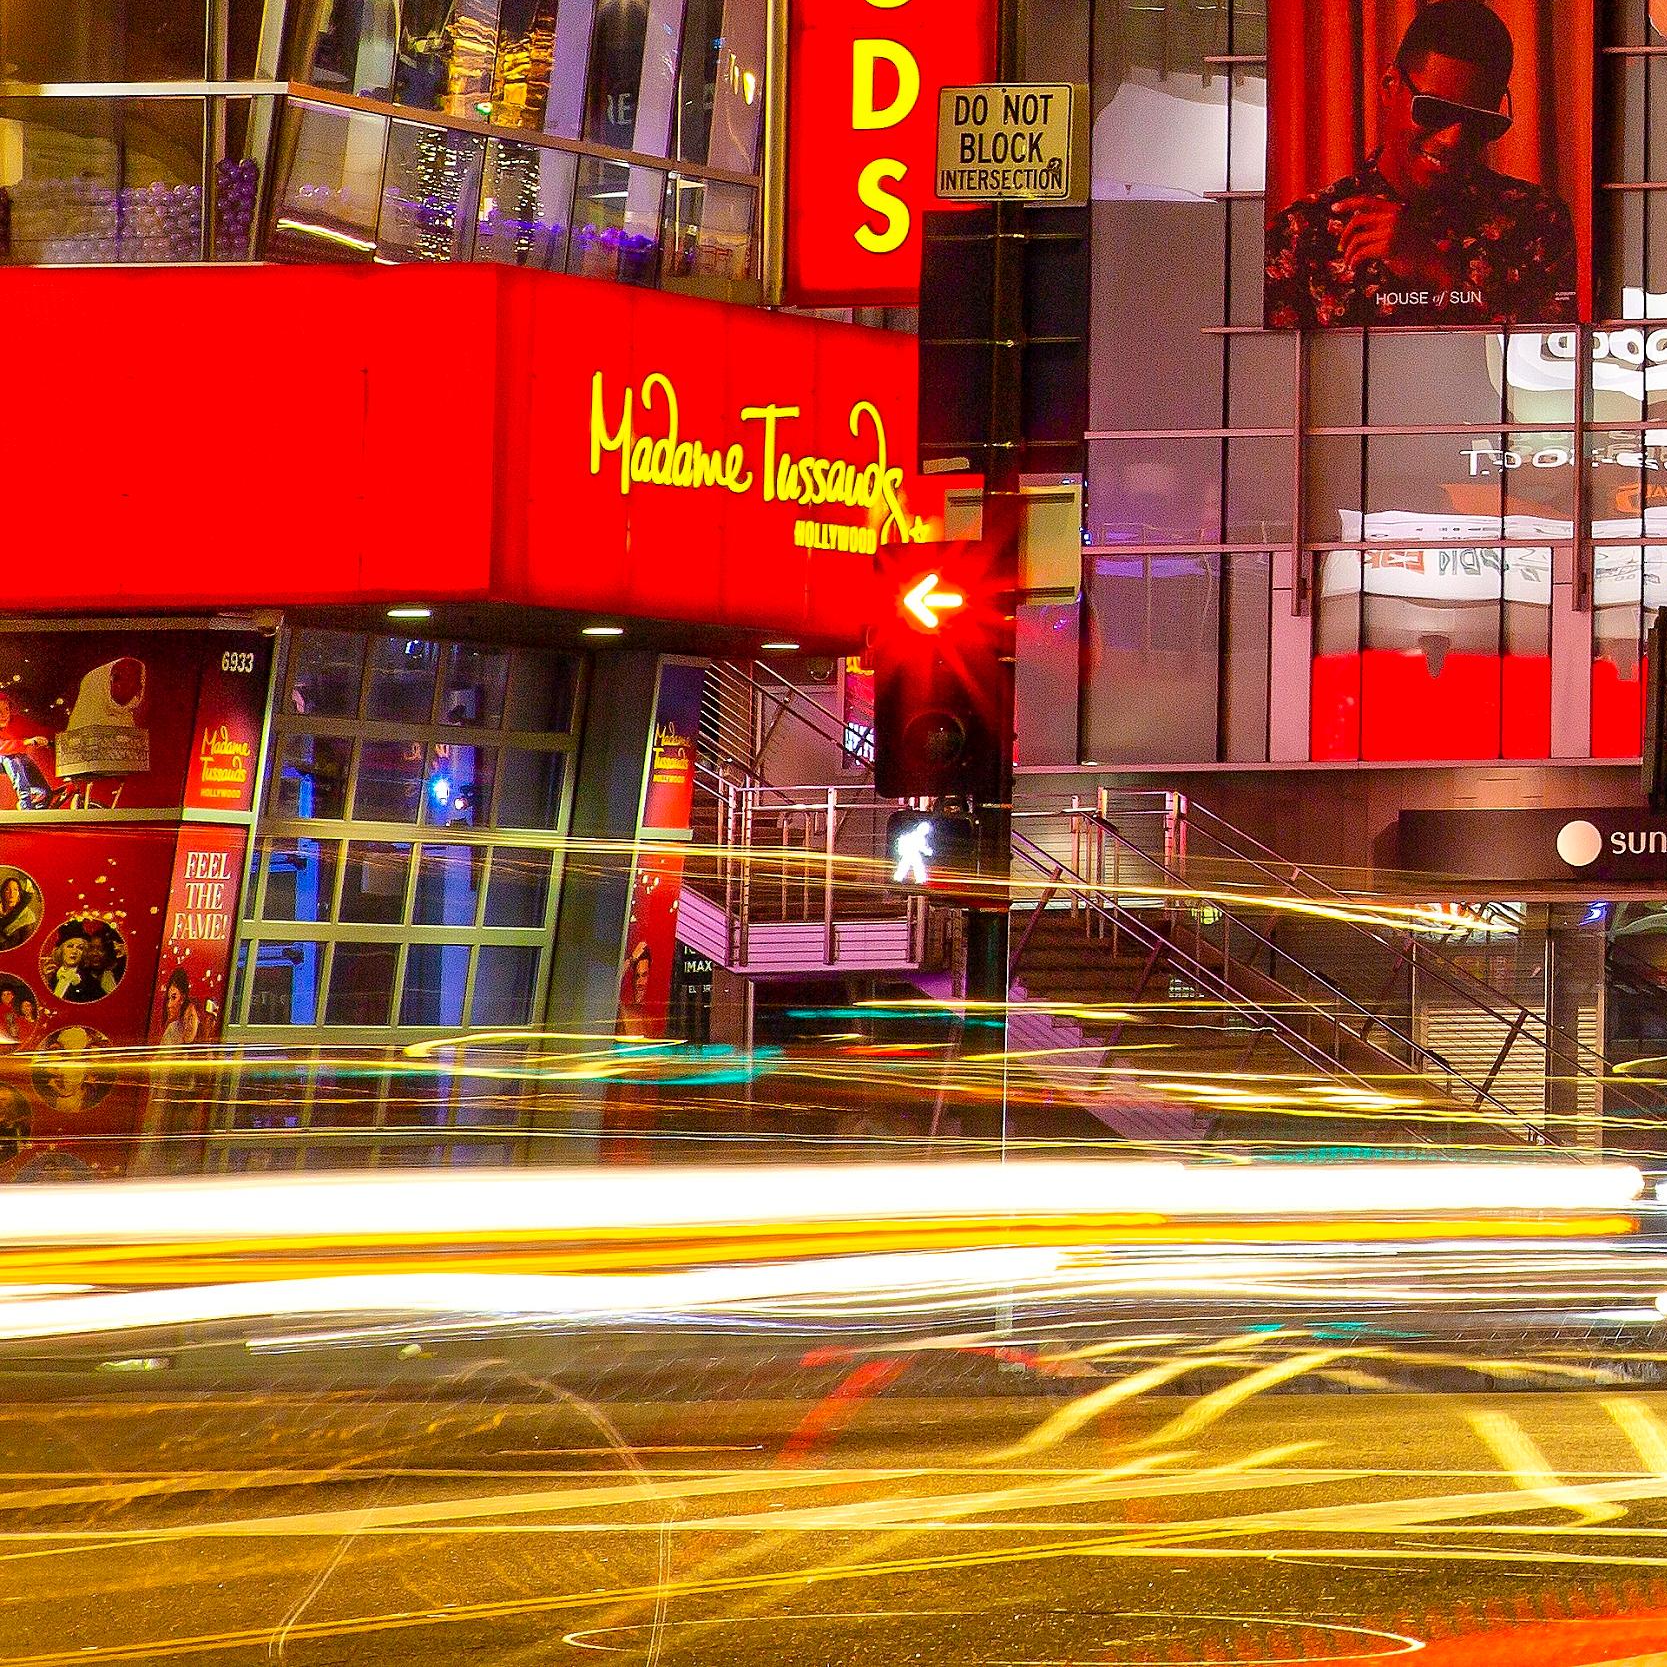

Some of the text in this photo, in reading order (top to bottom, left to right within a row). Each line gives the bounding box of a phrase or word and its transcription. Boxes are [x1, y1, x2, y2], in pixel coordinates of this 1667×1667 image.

[954, 94, 1054, 126] DO NOT
[960, 131, 1044, 164] BLOCK
[940, 168, 1062, 191] INTERSECTION
[1376, 290, 1482, 307] HOUSE of SUN
[590, 370, 911, 546] Madame Tussauds
[794, 519, 877, 555] HOLLYWOOD
[221, 650, 254, 673] 6933
[201, 725, 251, 756] Madame
[200, 755, 248, 784] Tussauds
[185, 852, 231, 880] FEEL
[186, 882, 225, 911] THE
[171, 912, 228, 941] FAME!
[684, 960, 713, 973] IMAX
